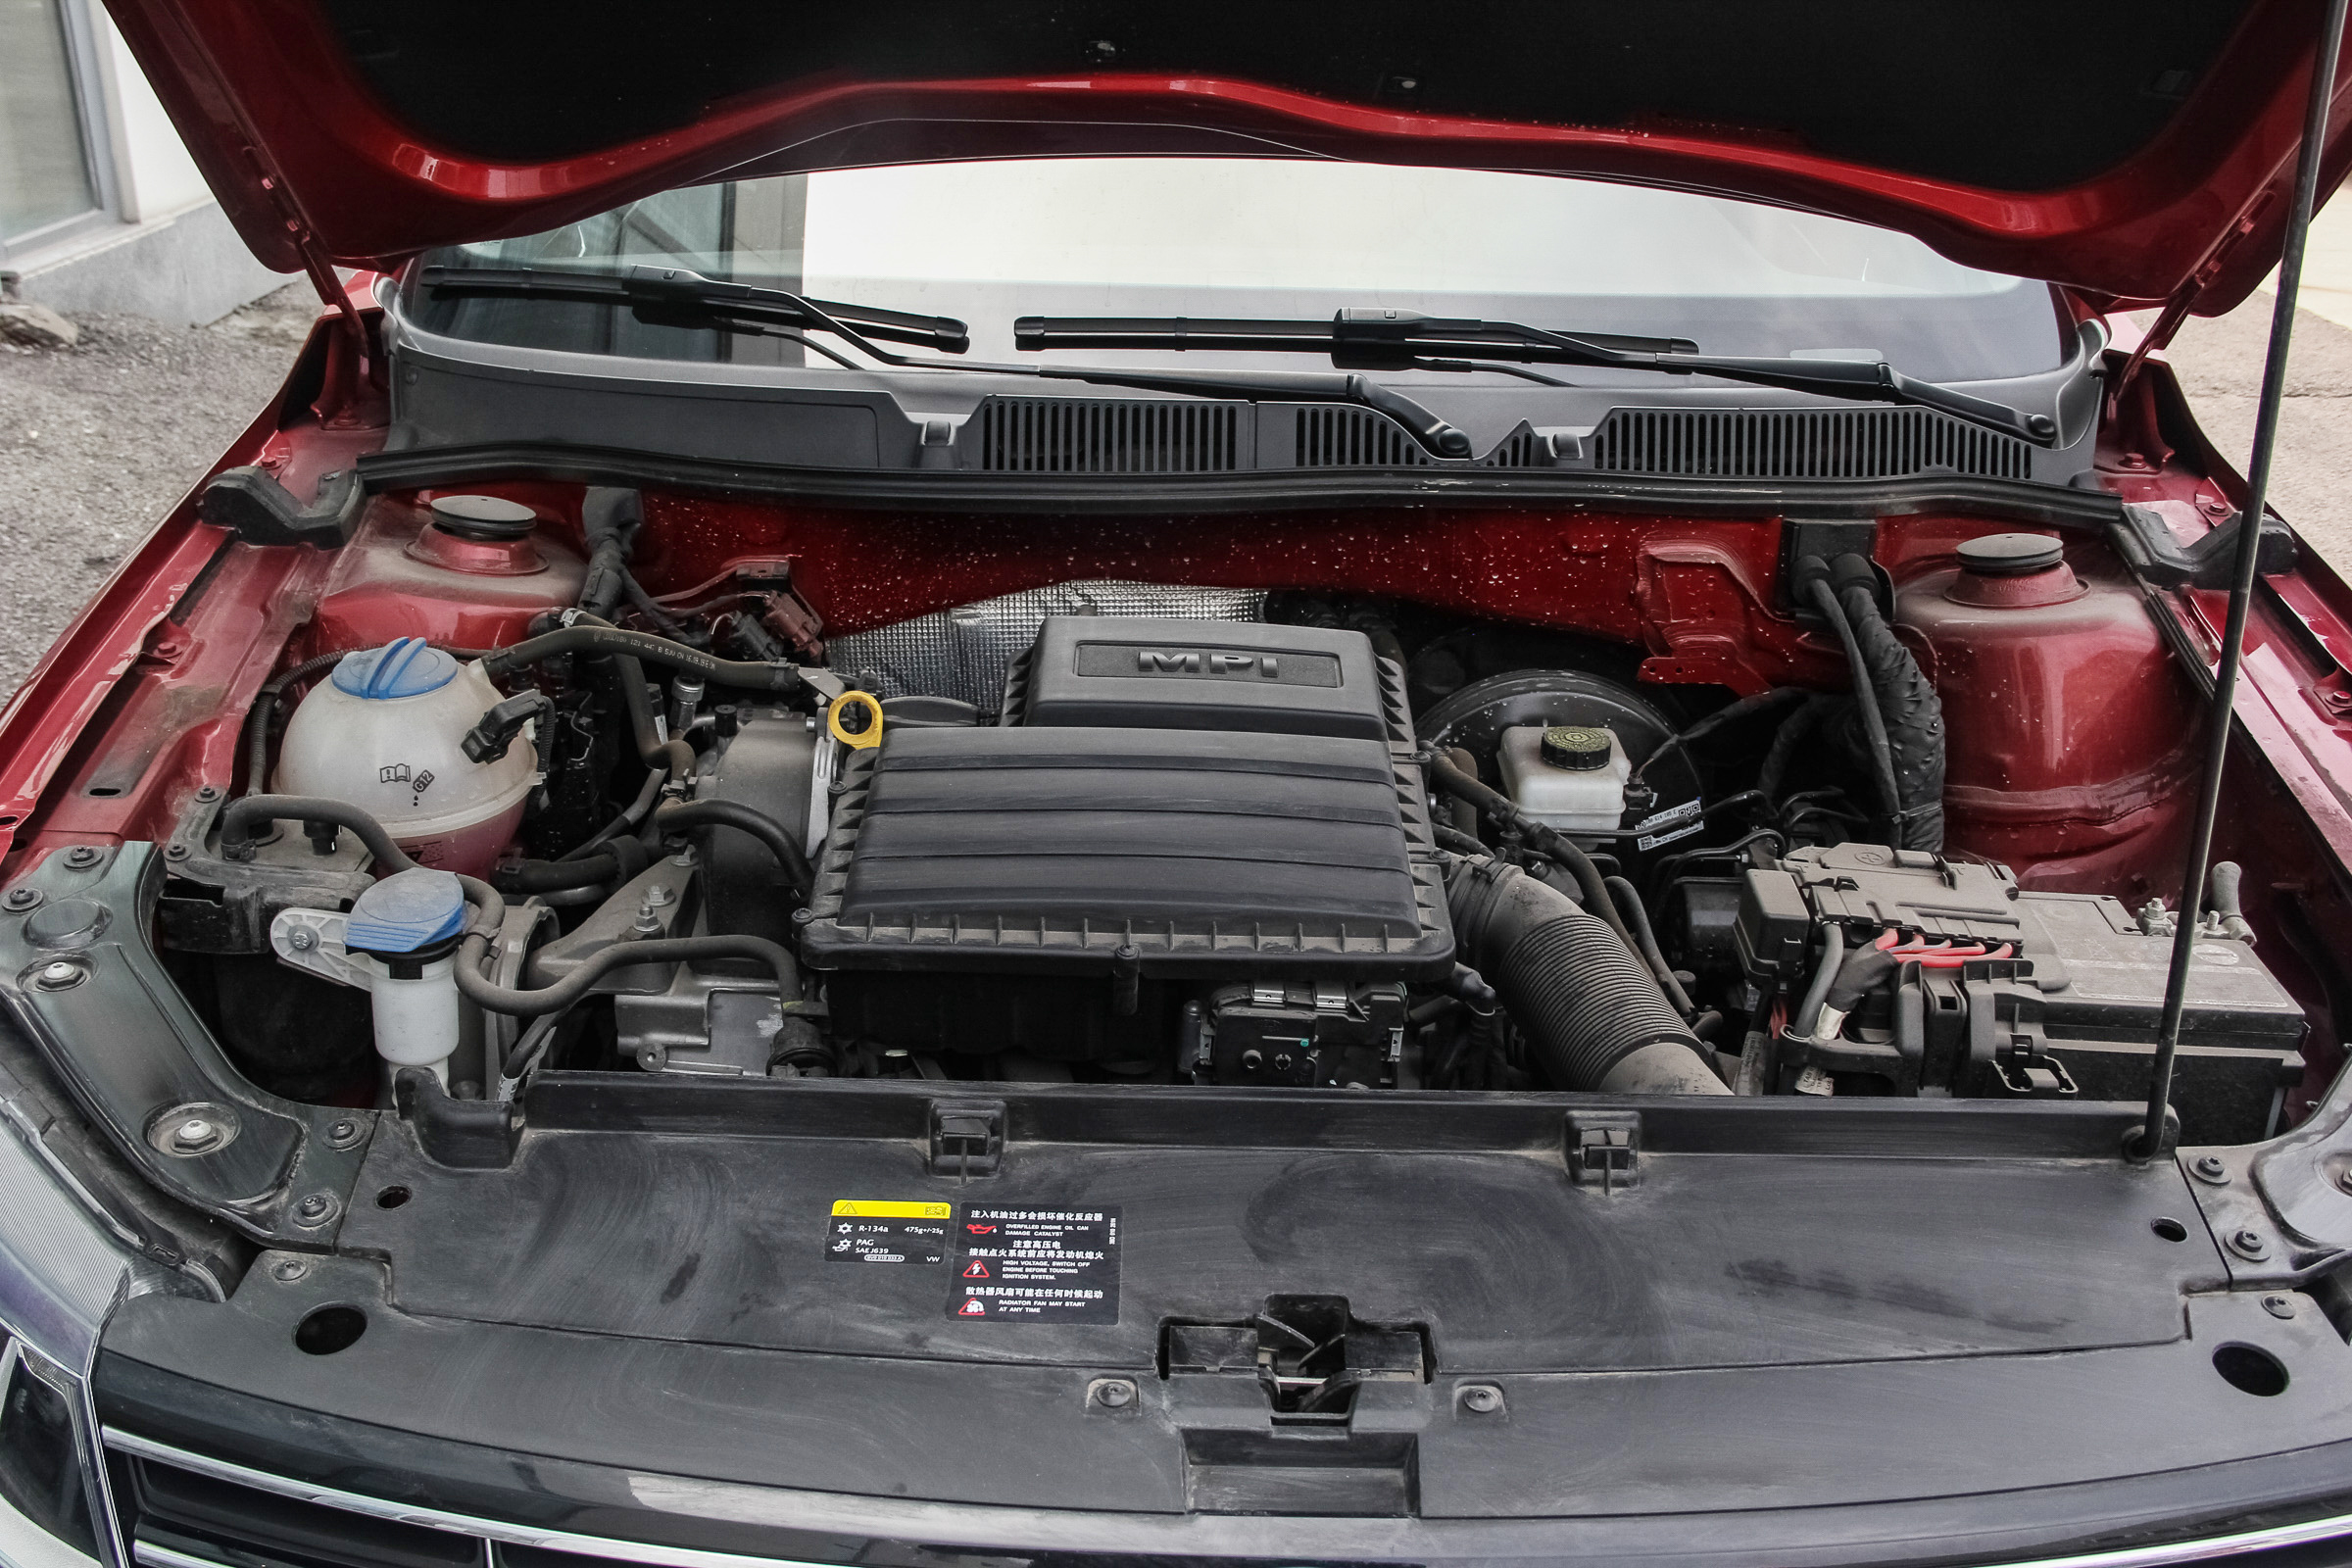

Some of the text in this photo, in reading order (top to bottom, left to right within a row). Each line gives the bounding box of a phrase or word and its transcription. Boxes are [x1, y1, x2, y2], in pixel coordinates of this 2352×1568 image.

[630, 638, 641, 647] 121
[1138, 651, 1279, 678] MPI
[414, 771, 433, 791] G12
[970, 1209, 1103, 1222] 注入机油过多会损坏催化反应器
[1012, 1239, 1061, 1250] 注意高压电
[969, 1247, 1104, 1260] 接触点火系统前应将发动机熄火
[966, 1286, 1103, 1299] 散热器风扇可能在任何时候起动
